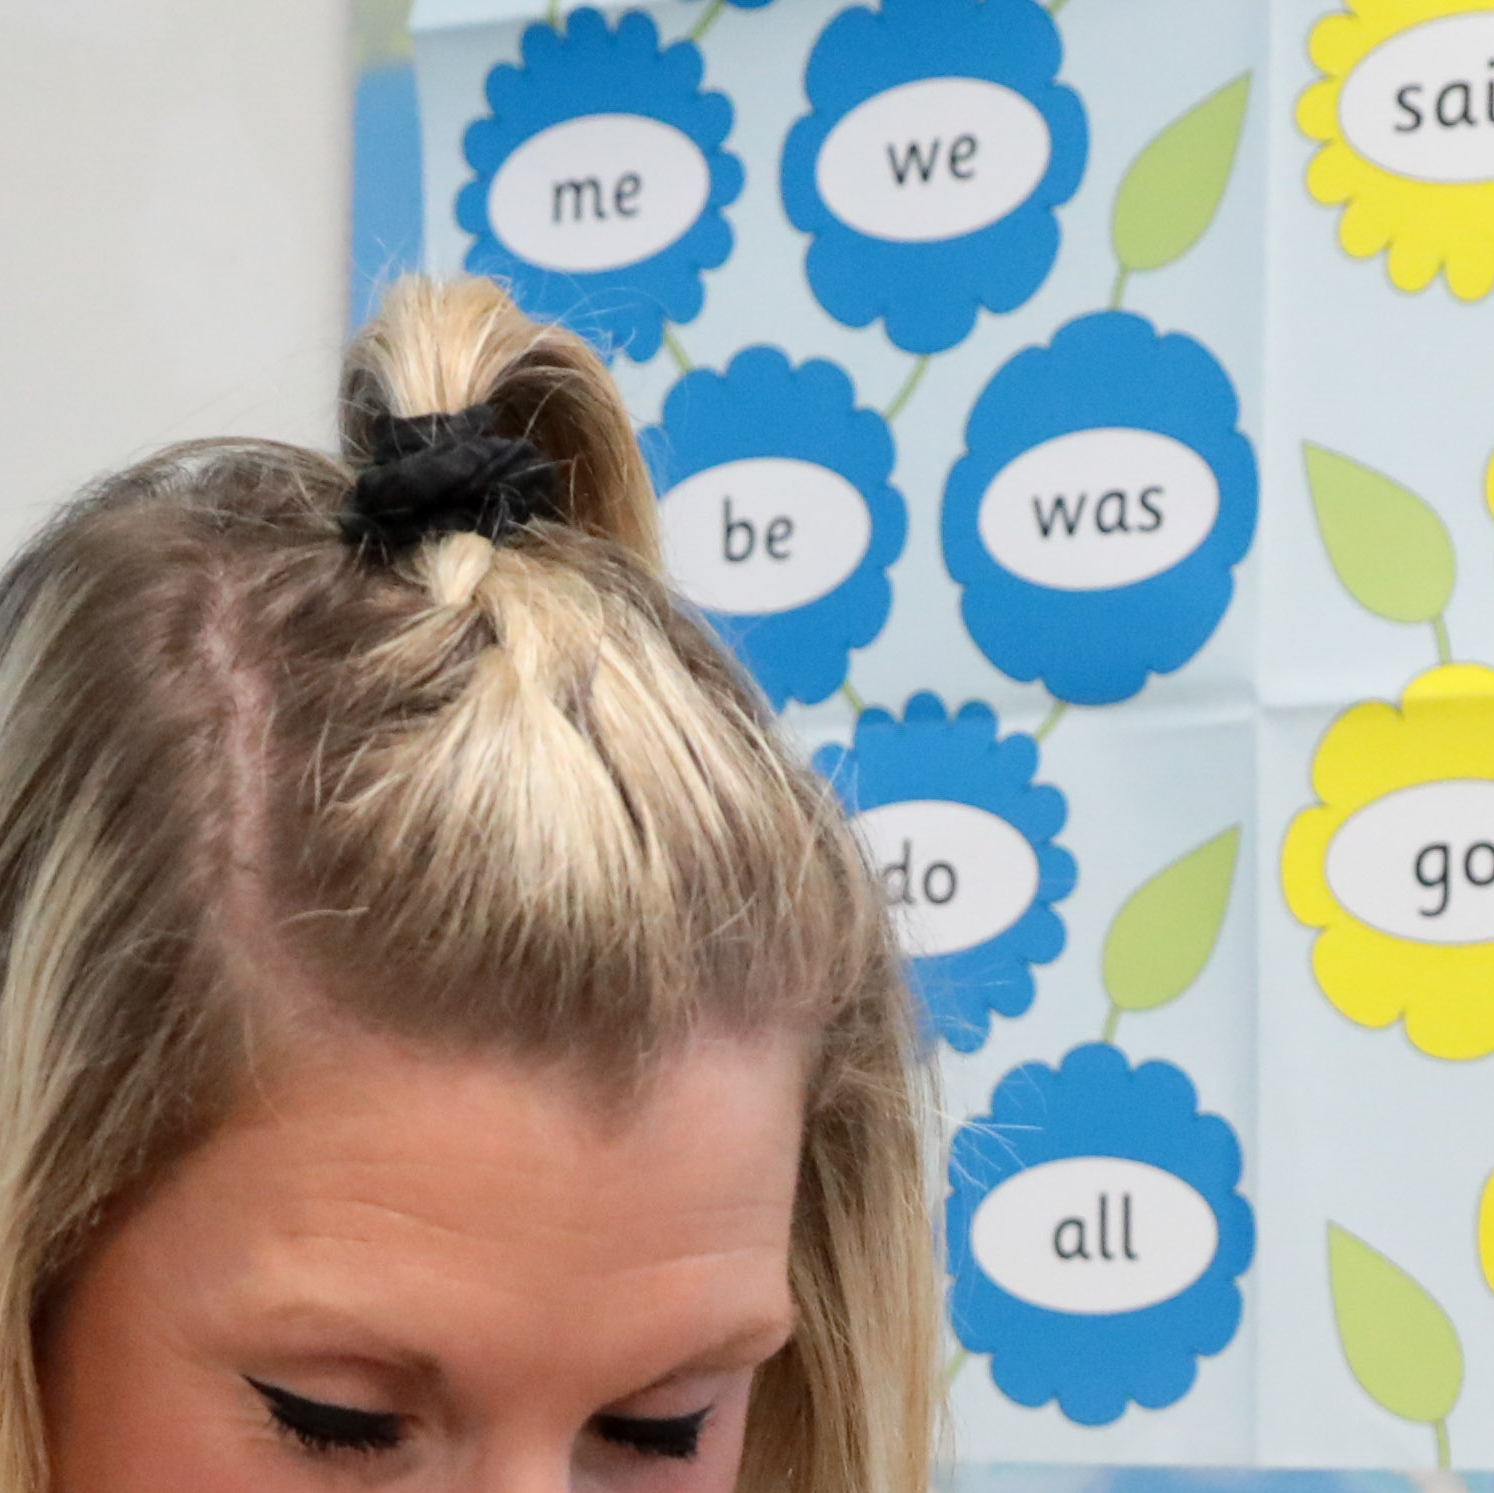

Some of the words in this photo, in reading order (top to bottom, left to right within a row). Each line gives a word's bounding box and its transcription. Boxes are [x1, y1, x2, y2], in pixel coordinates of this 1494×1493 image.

[886, 132, 978, 187] we
[551, 171, 643, 224] me
[721, 496, 796, 564] be
[1031, 485, 1165, 539] was
[881, 838, 958, 906] do
[1051, 1192, 1139, 1263] all
